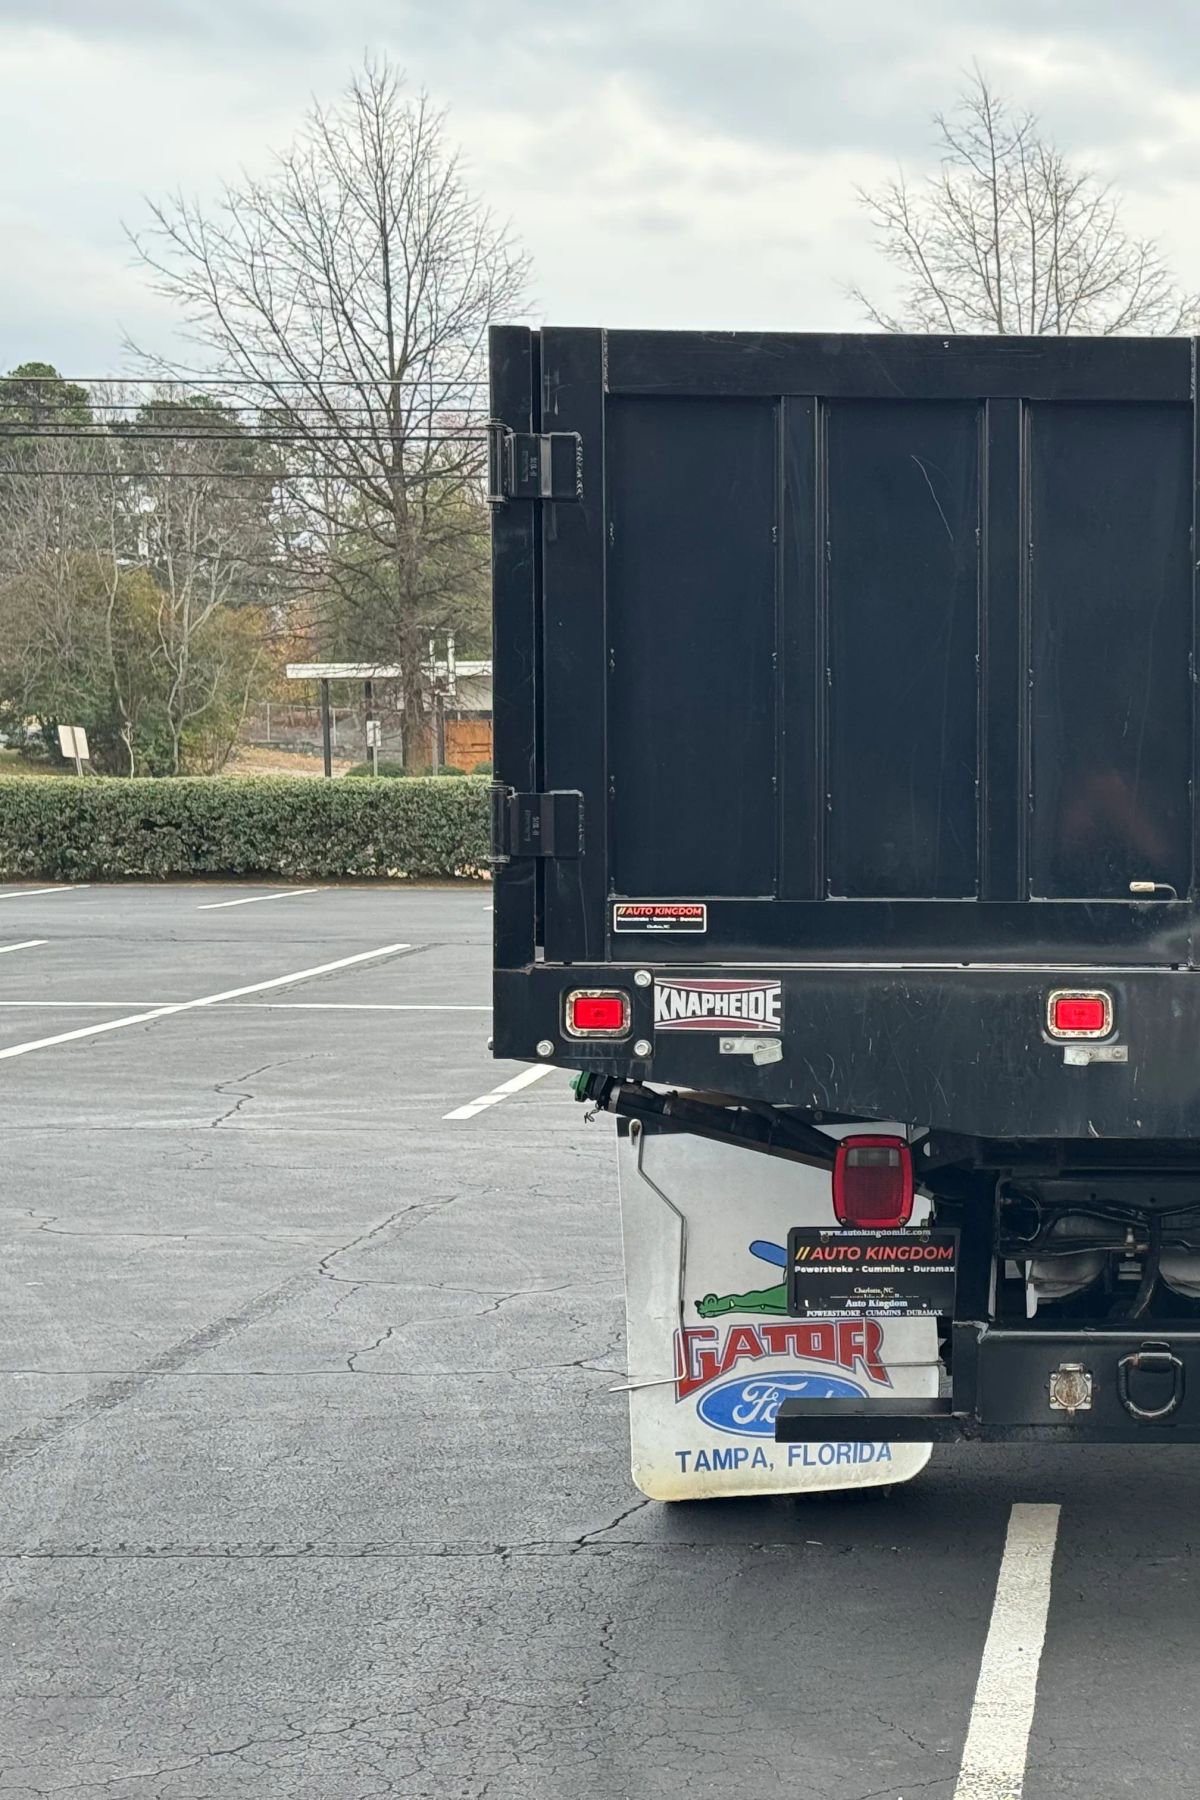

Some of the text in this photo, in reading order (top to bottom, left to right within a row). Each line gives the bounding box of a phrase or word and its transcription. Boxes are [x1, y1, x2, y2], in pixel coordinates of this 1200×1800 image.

[655, 907, 702, 915] KINGDOM
[654, 985, 781, 1024] KNAPHEIDE
[865, 1246, 954, 1260] KINGDOM
[794, 1265, 853, 1273] Powerstroke
[861, 1265, 905, 1273] Cummins
[913, 1265, 956, 1273] Duramax
[845, 1300, 908, 1309] Auto Kingdom
[674, 1319, 893, 1404] GATOR
[675, 1442, 892, 1474] TAMPA, FLORIDA
